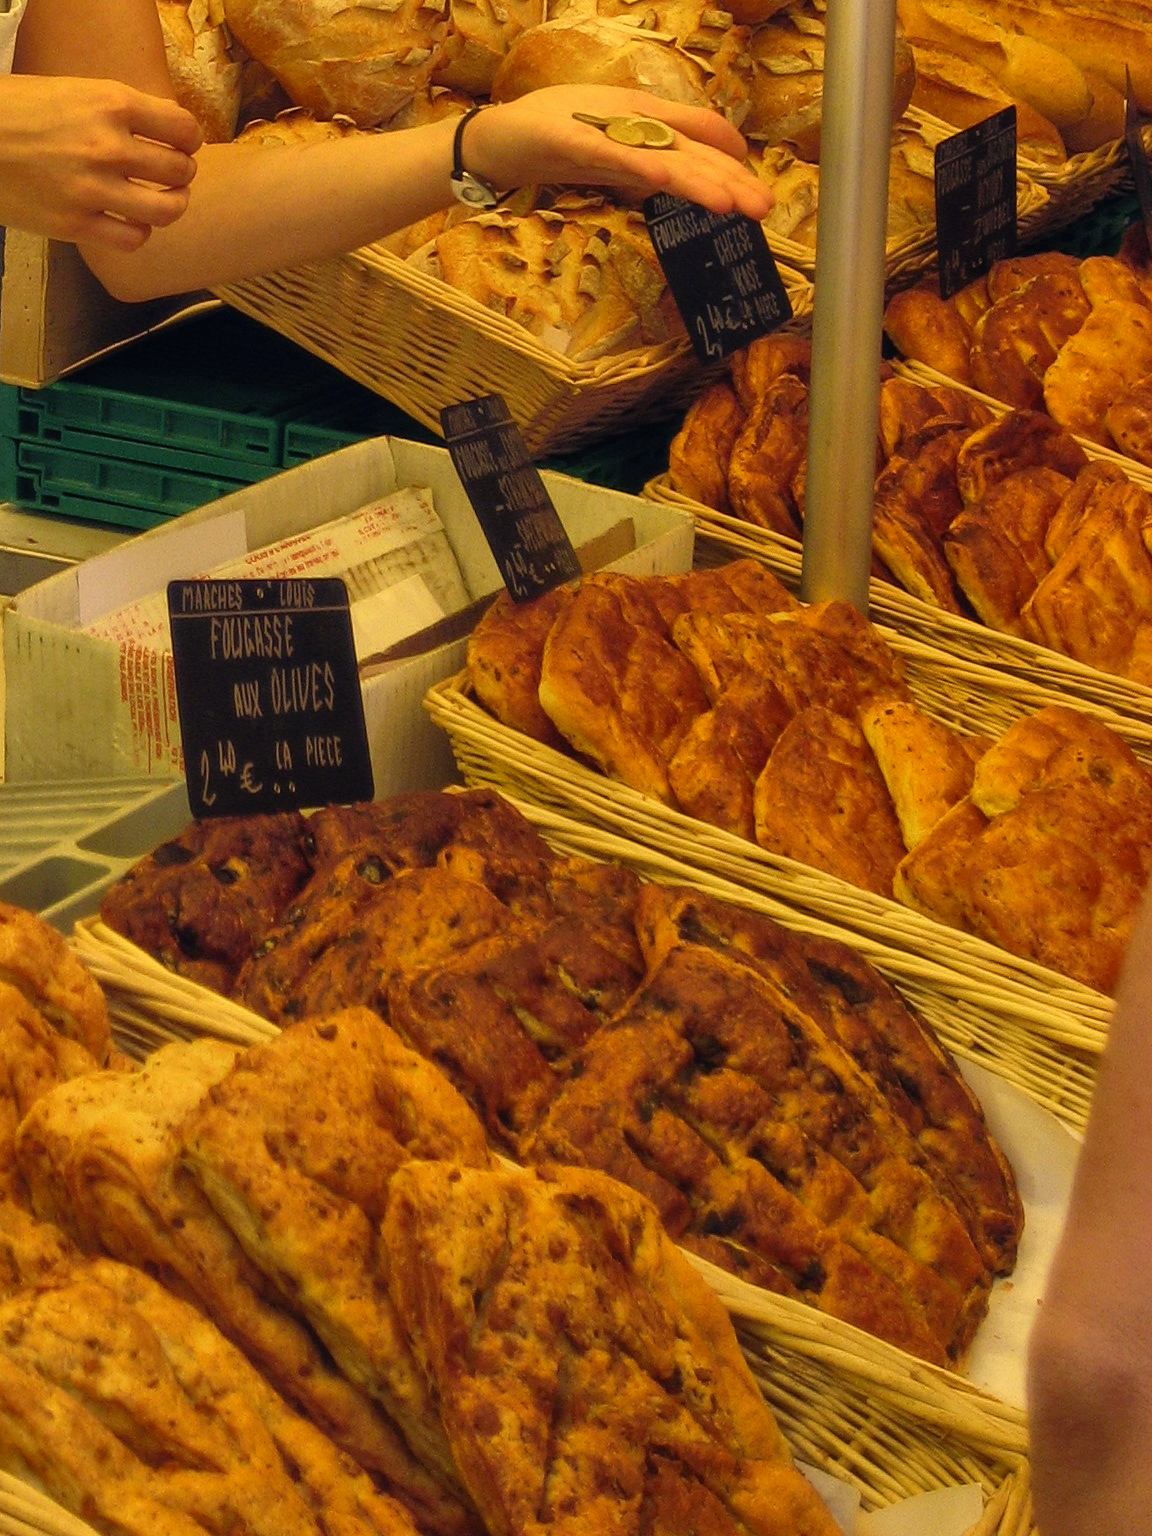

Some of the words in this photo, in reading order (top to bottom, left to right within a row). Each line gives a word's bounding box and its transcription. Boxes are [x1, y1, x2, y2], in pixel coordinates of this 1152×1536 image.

[653, 211, 699, 255] FOUGASSE
[713, 221, 754, 265] CHEESE
[182, 582, 242, 611] MARCHES
[210, 615, 293, 659] FOUGASSE
[233, 680, 263, 719] AUX
[271, 662, 334, 715] OLIVES
[275, 740, 293, 770] LA
[305, 735, 343, 767] PIECE
